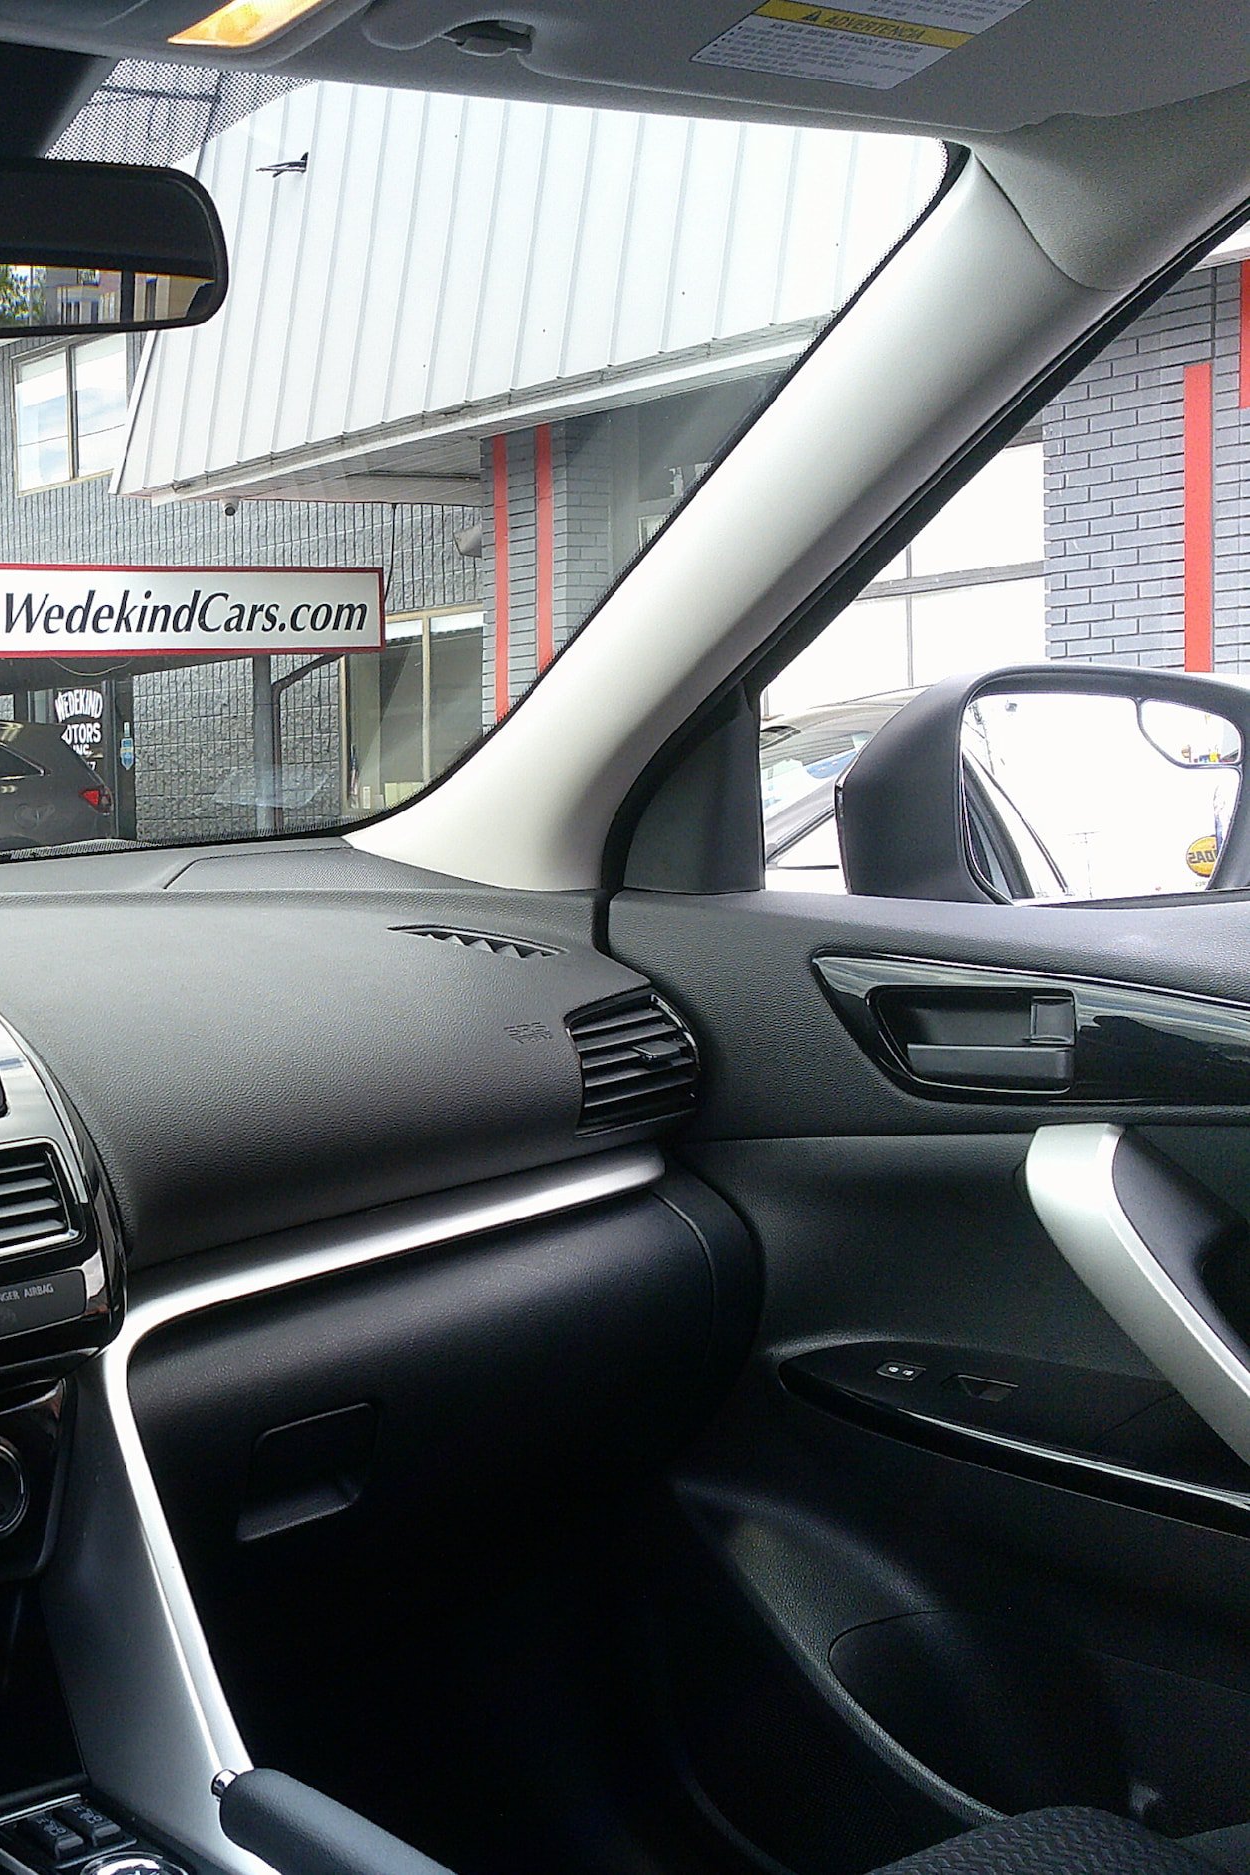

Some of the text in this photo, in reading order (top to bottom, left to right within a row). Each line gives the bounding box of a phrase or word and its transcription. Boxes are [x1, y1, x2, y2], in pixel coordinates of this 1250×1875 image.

[4, 590, 368, 635] WedekindCars.com
[54, 688, 104, 724] WEDEKIND
[24, 1283, 54, 1299] AIRBAG
